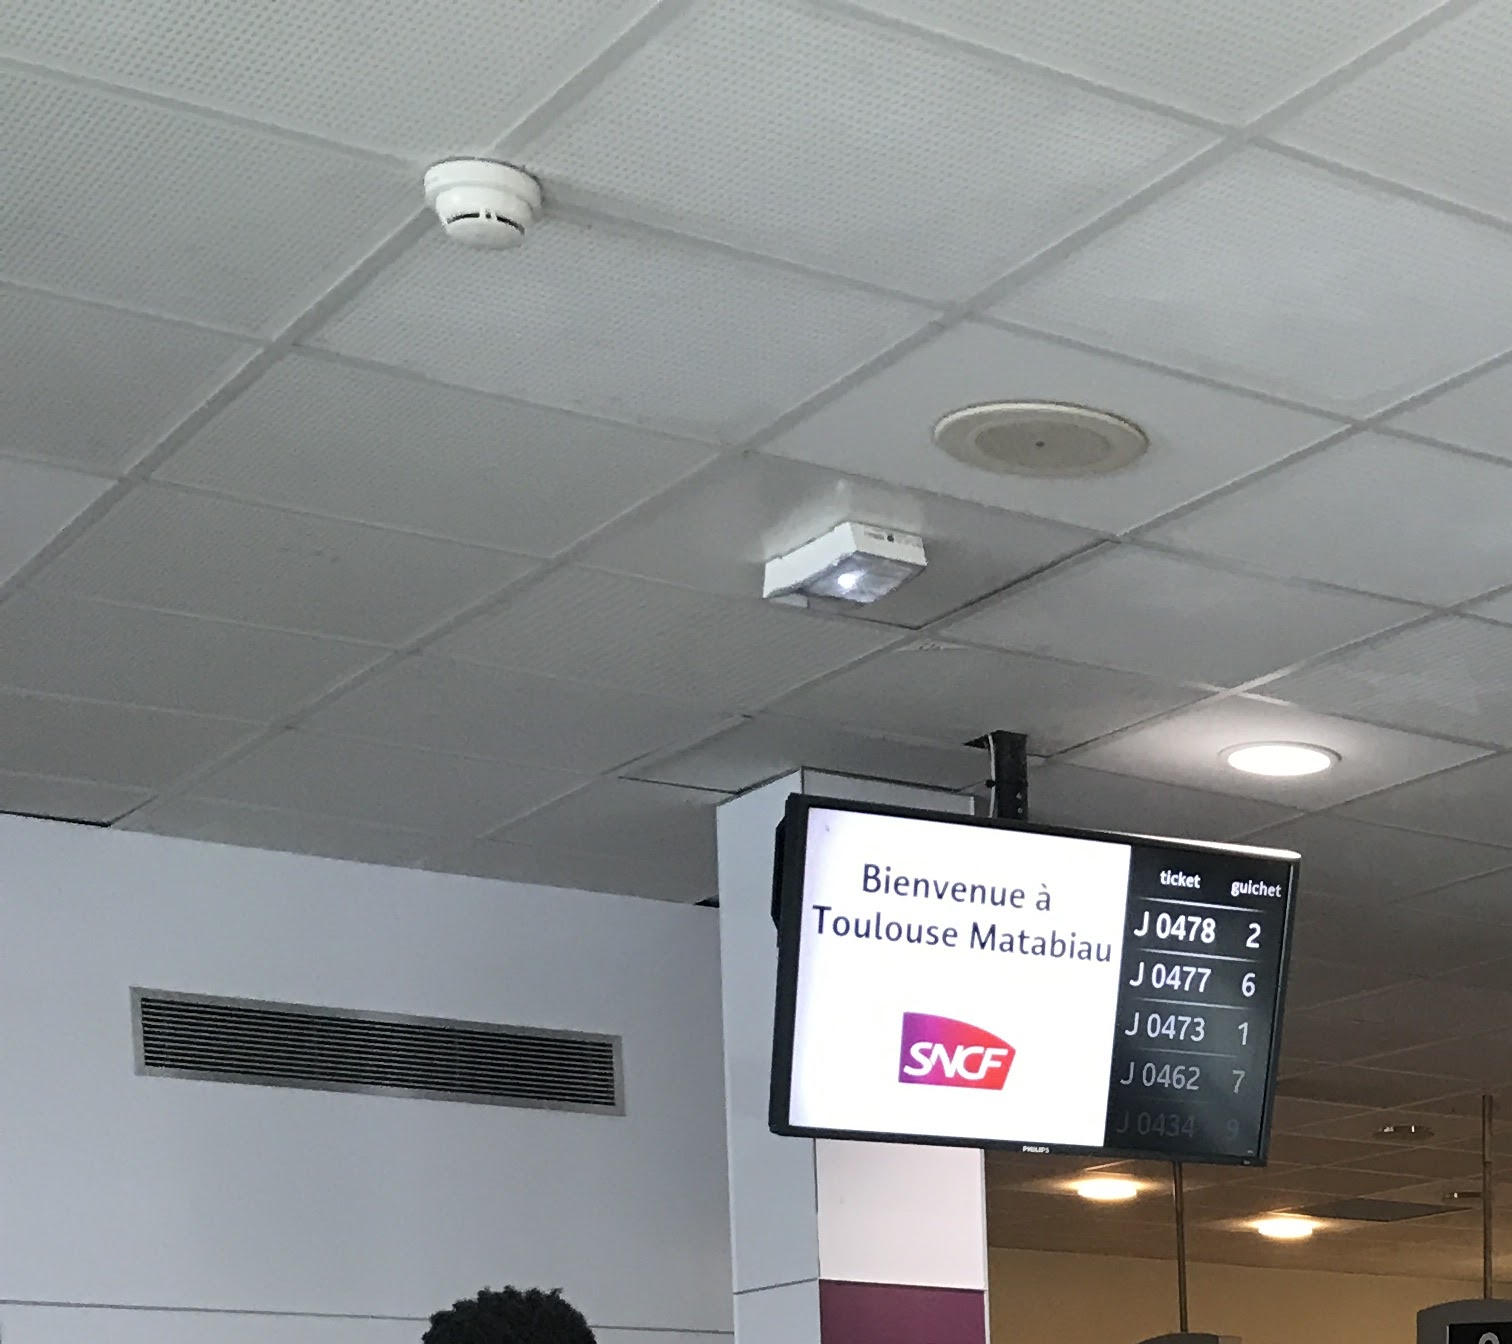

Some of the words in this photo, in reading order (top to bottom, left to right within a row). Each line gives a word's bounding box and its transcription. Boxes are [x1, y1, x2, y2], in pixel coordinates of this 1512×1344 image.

[862, 863, 1026, 909] Bienvenue
[1036, 883, 1051, 911] à
[1160, 870, 1201, 889] ticket
[1231, 878, 1282, 899] guichet
[813, 905, 958, 948] Toulouse
[970, 921, 1113, 963] Matabiau
[1134, 911, 1149, 938] J
[1157, 912, 1216, 944] 0478
[1246, 923, 1260, 949] 2
[1129, 962, 1144, 987] J
[1151, 963, 1212, 994] 0477
[1241, 972, 1256, 998] 6
[1125, 1012, 1140, 1037] J
[1146, 1013, 1206, 1042] 0473
[1238, 1021, 1249, 1045] 1
[903, 1041, 1010, 1080] SNCF
[1120, 1060, 1135, 1086] J
[1141, 1061, 1201, 1090] 0462
[1231, 1069, 1245, 1094] 7
